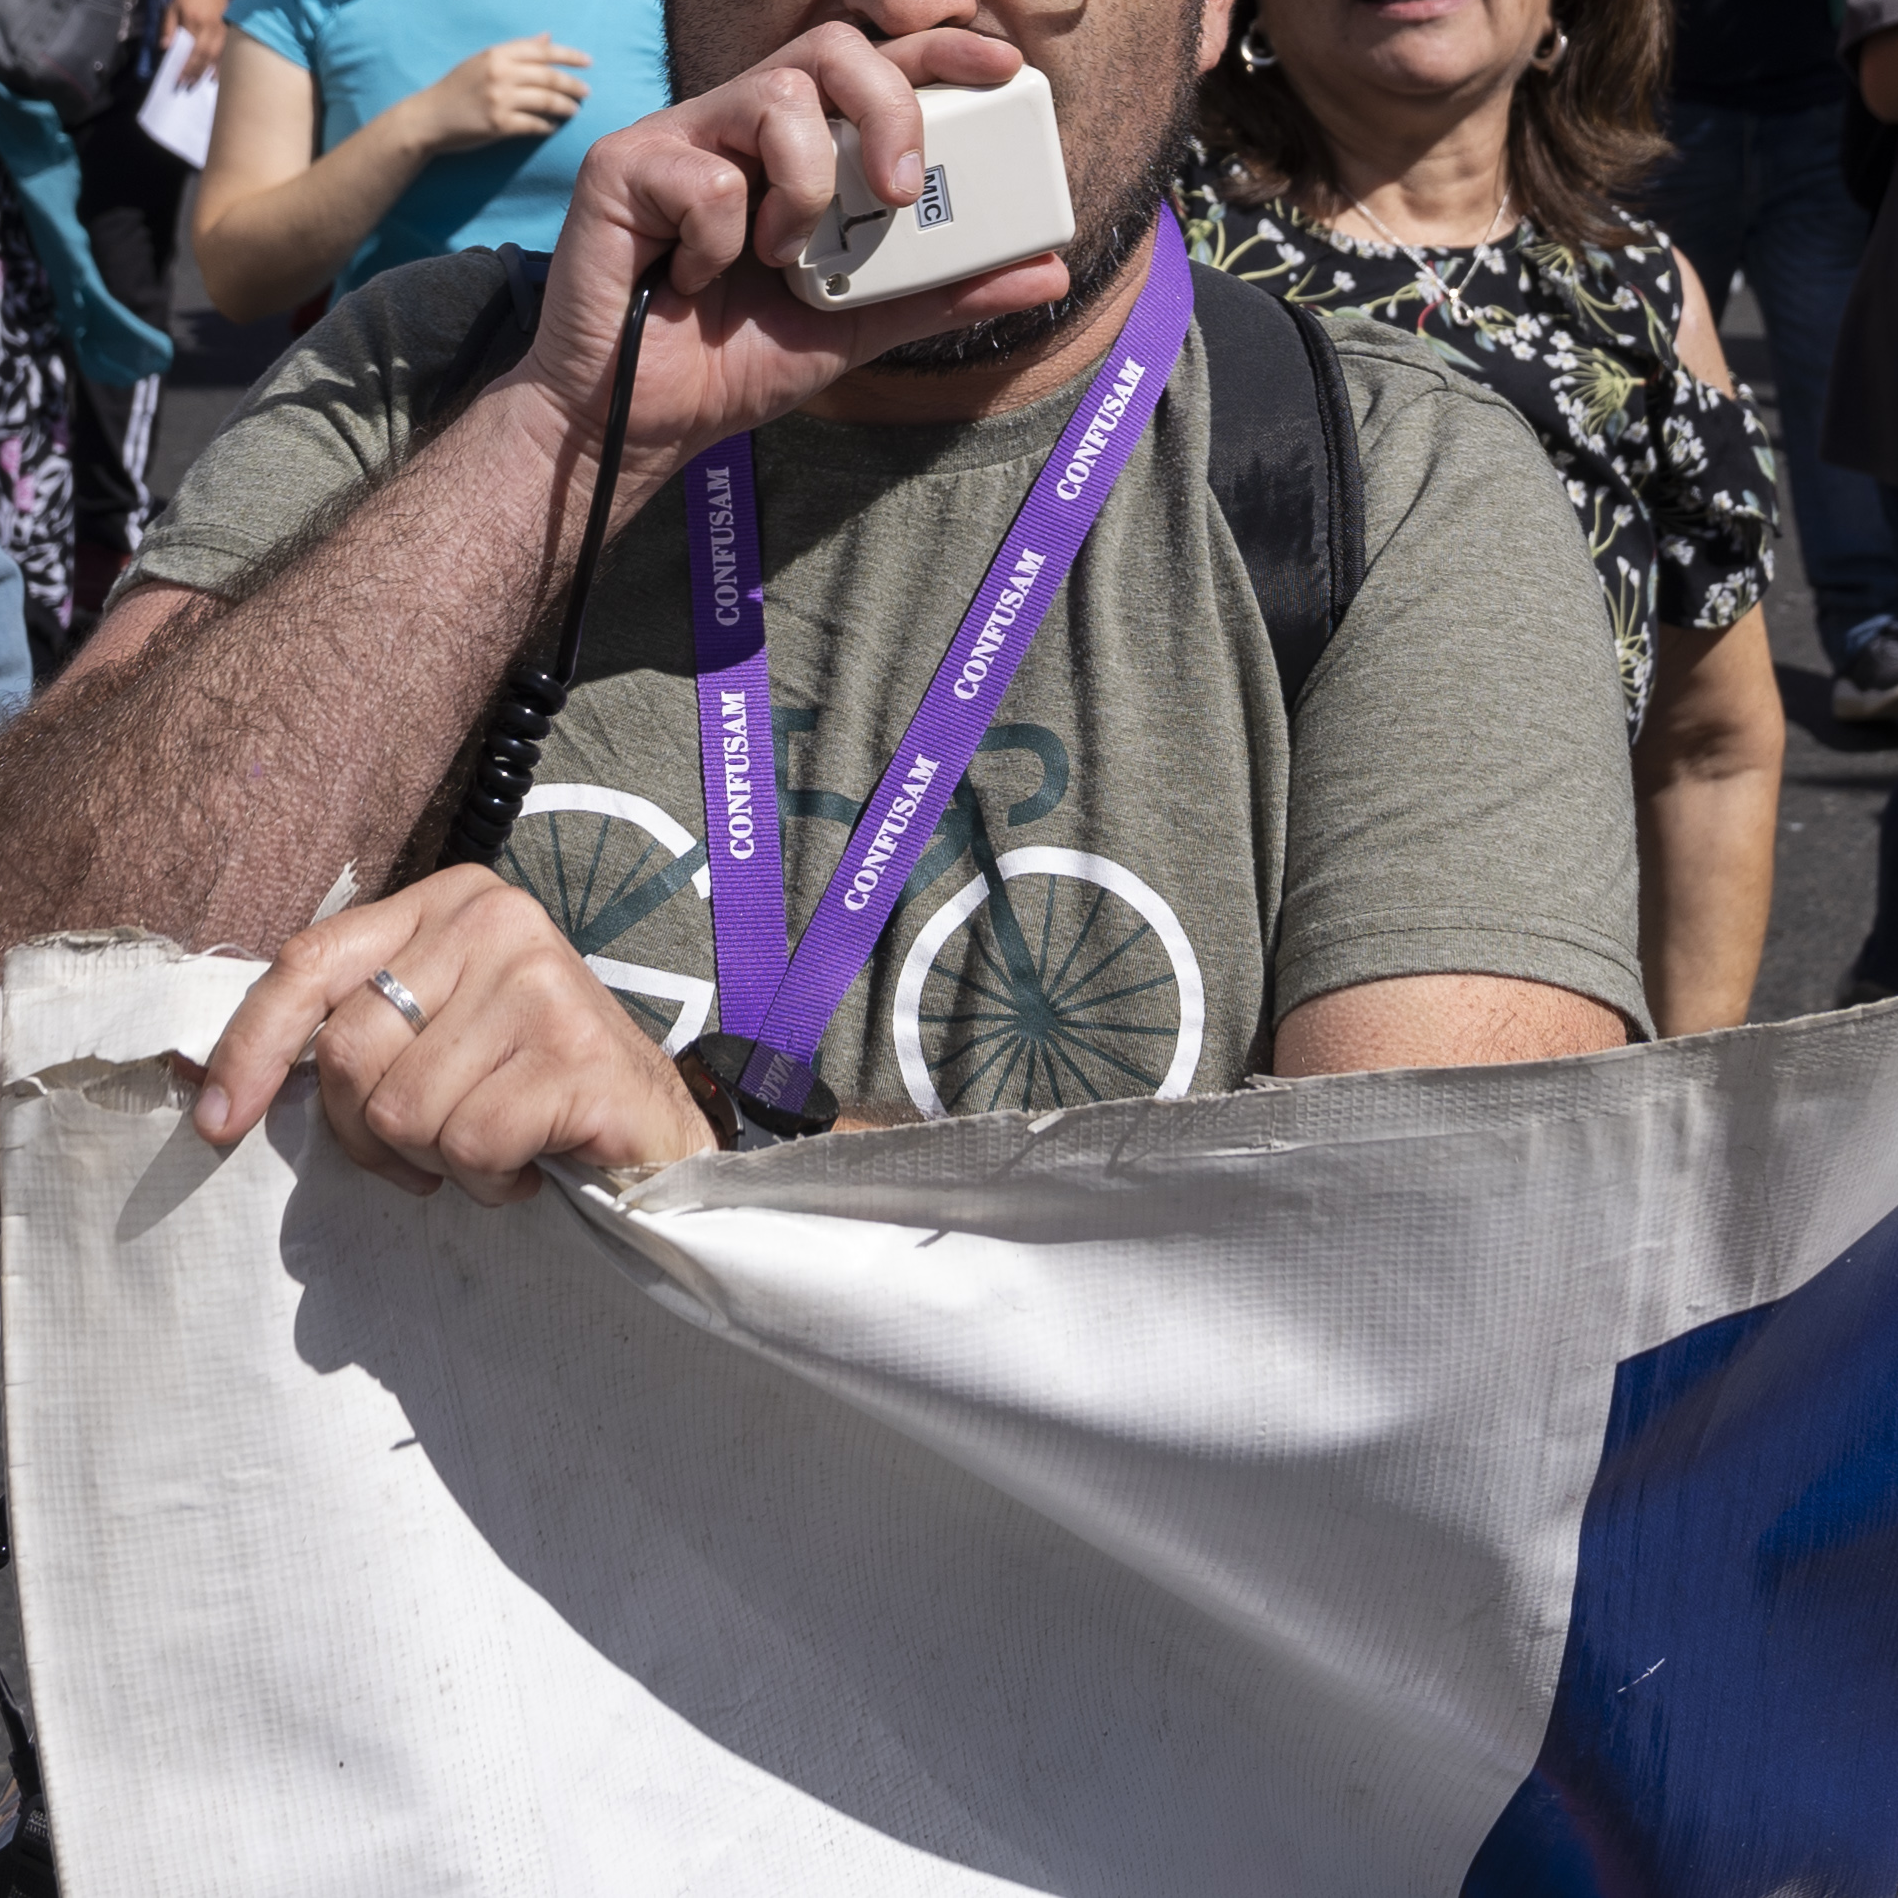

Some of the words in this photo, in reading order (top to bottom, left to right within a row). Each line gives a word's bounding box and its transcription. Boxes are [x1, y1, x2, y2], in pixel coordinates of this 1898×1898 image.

[921, 173, 943, 222] MIC
[1056, 356, 1146, 502] CONFUSAM
[706, 466, 741, 627] CONFUSAM
[953, 548, 1047, 701] CONFUSAM
[725, 690, 757, 862] CONFUSAM
[843, 755, 941, 911] CONFUSAM
